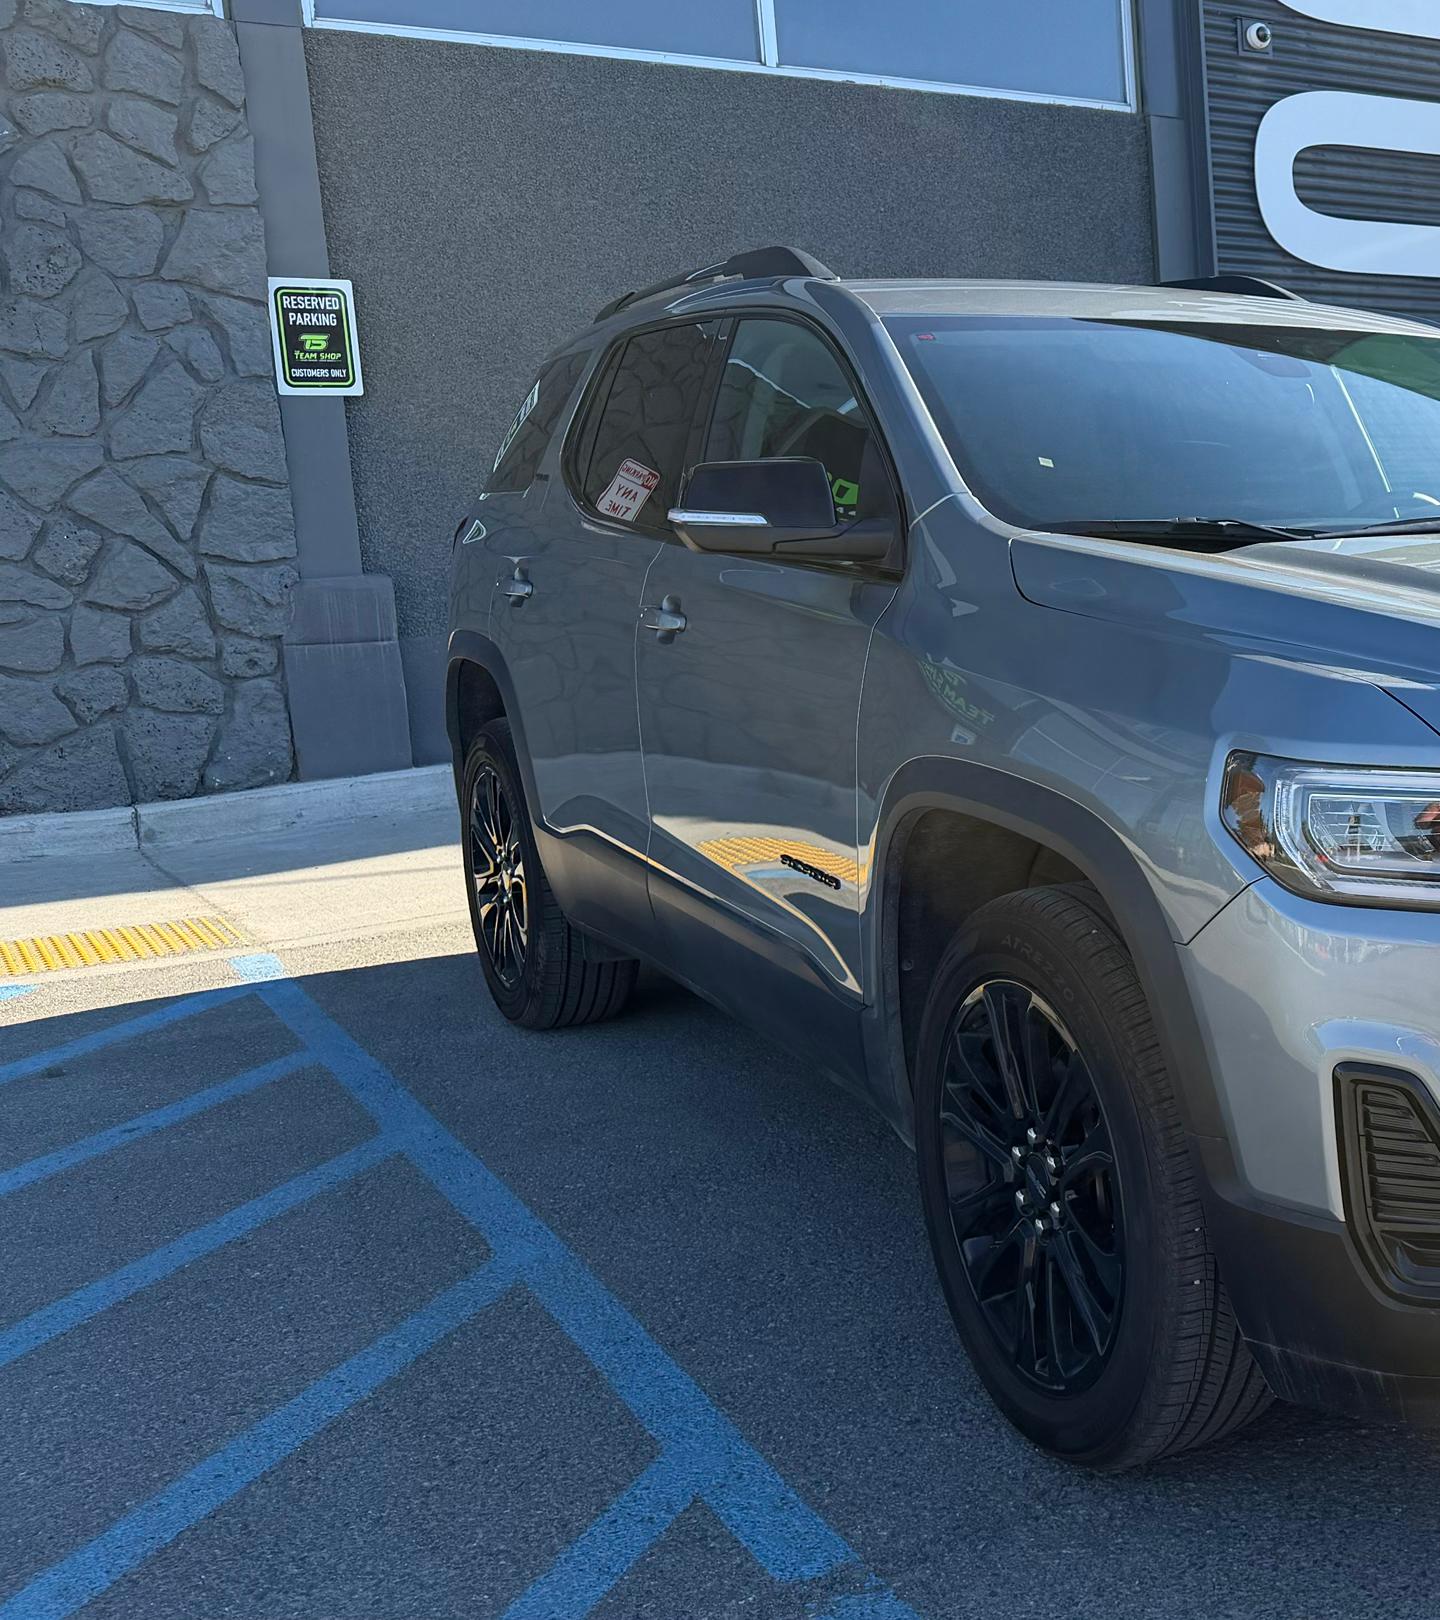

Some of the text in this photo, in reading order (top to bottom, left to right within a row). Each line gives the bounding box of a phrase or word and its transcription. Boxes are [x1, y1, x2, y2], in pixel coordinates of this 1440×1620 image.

[282, 295, 339, 310] RESERVED
[288, 312, 337, 326] PARKING
[294, 352, 342, 360] TEAM SHOP
[291, 368, 347, 378] CUSTOMERS ONLY
